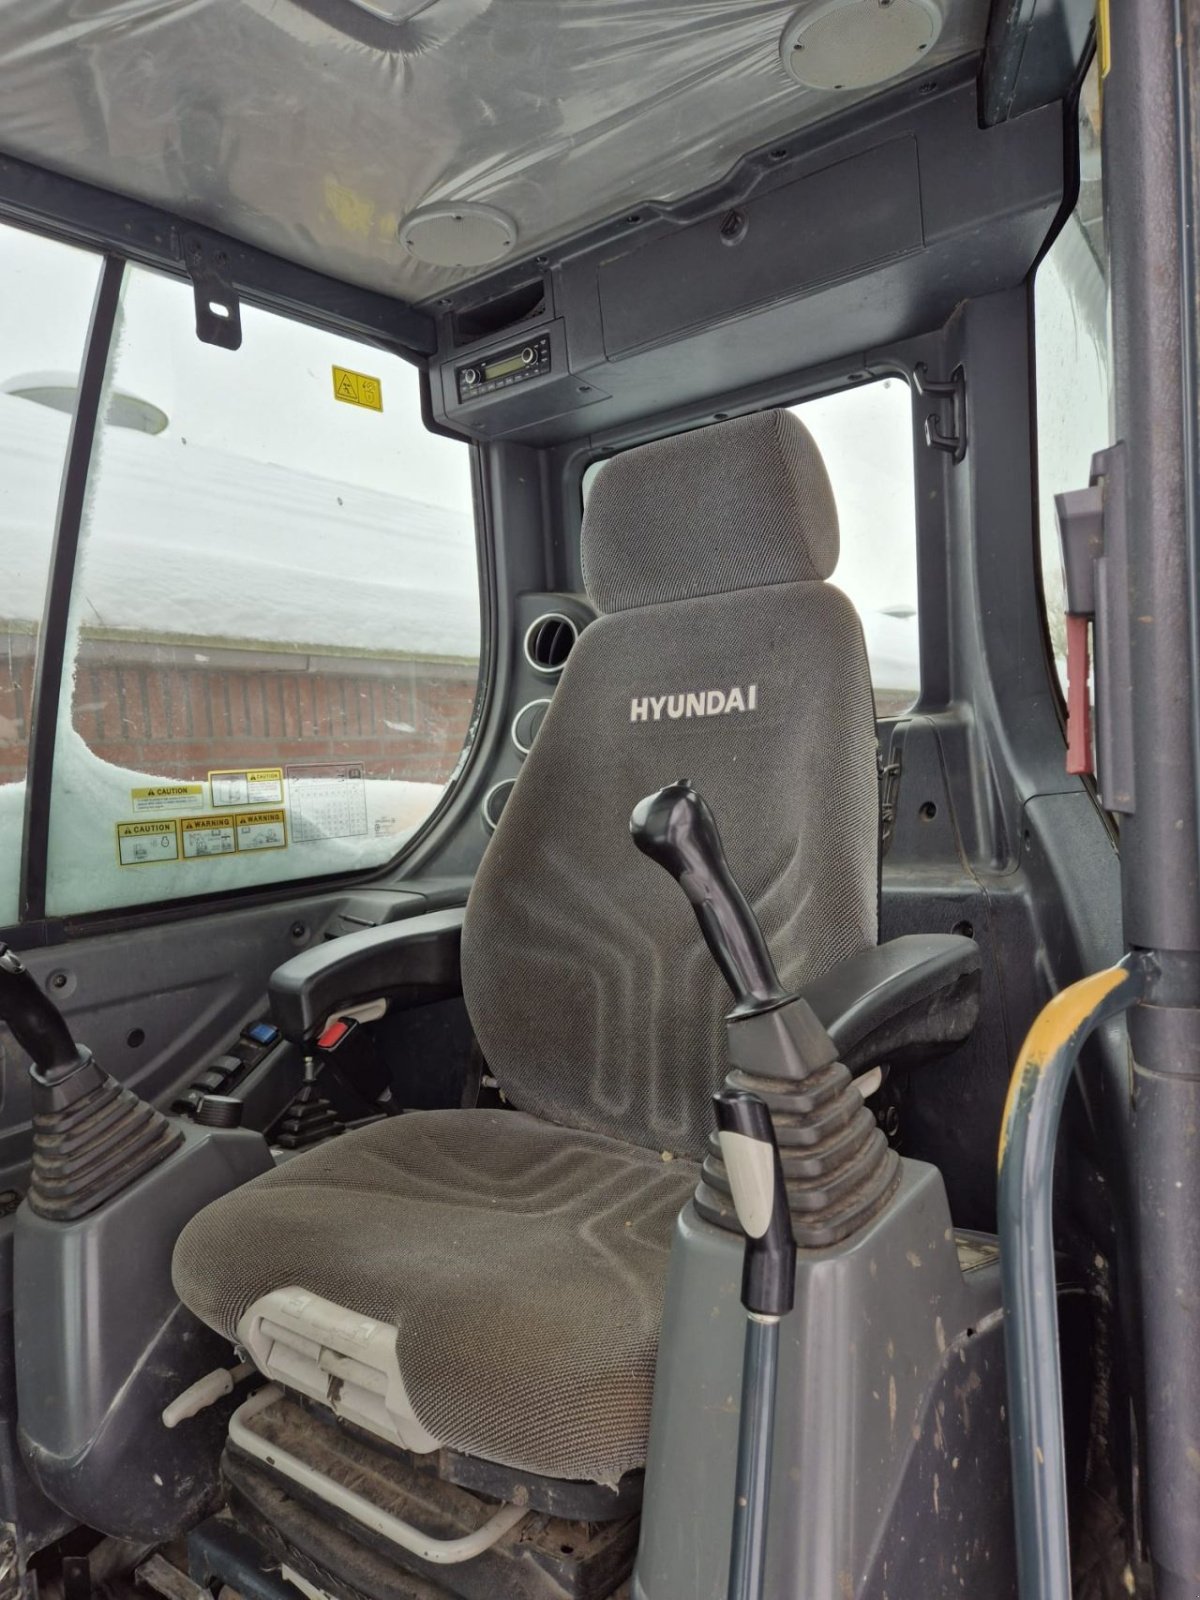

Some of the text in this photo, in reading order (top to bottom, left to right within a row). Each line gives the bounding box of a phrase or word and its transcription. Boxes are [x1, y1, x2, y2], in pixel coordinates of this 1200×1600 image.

[630, 685, 757, 722] HYUNDAI
[156, 787, 188, 796] CAUTION
[194, 818, 230, 828] WARNING
[247, 813, 280, 823] WARNING
[133, 823, 171, 834] CAUTION
